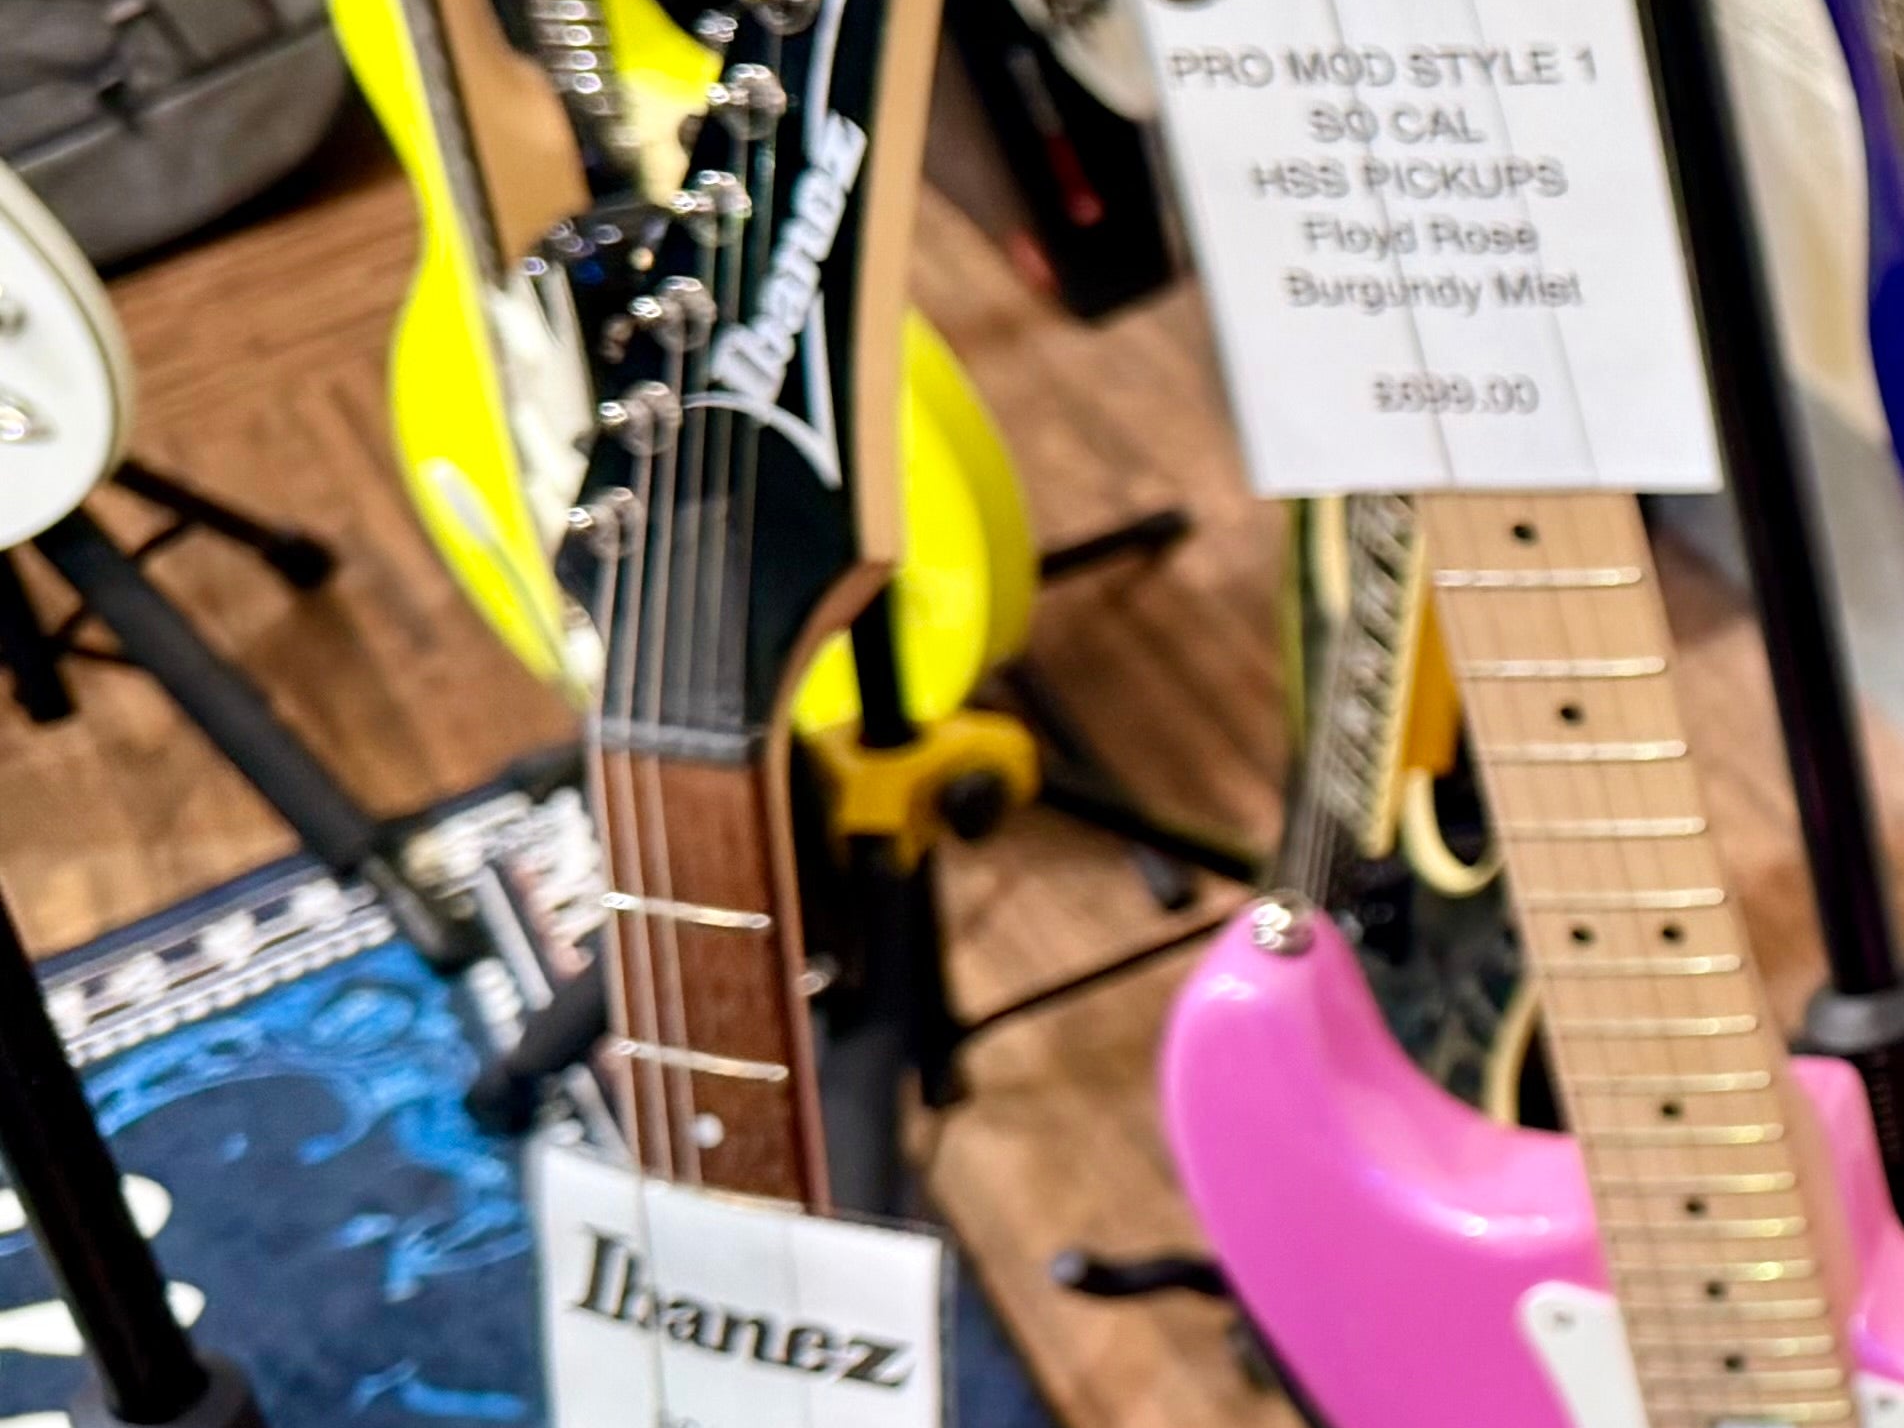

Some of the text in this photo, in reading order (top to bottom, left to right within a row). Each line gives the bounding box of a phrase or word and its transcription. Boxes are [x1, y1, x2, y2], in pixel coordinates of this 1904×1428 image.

[1167, 44, 1599, 89] PRO MOD STYLE 1
[1308, 99, 1487, 145] SO CAL
[1250, 153, 1570, 200] HSS PICKUPS
[1299, 212, 1540, 262] Floyd Rose
[1282, 267, 1585, 317] Burgundy Mist
[572, 1228, 914, 1390] Ibanez
